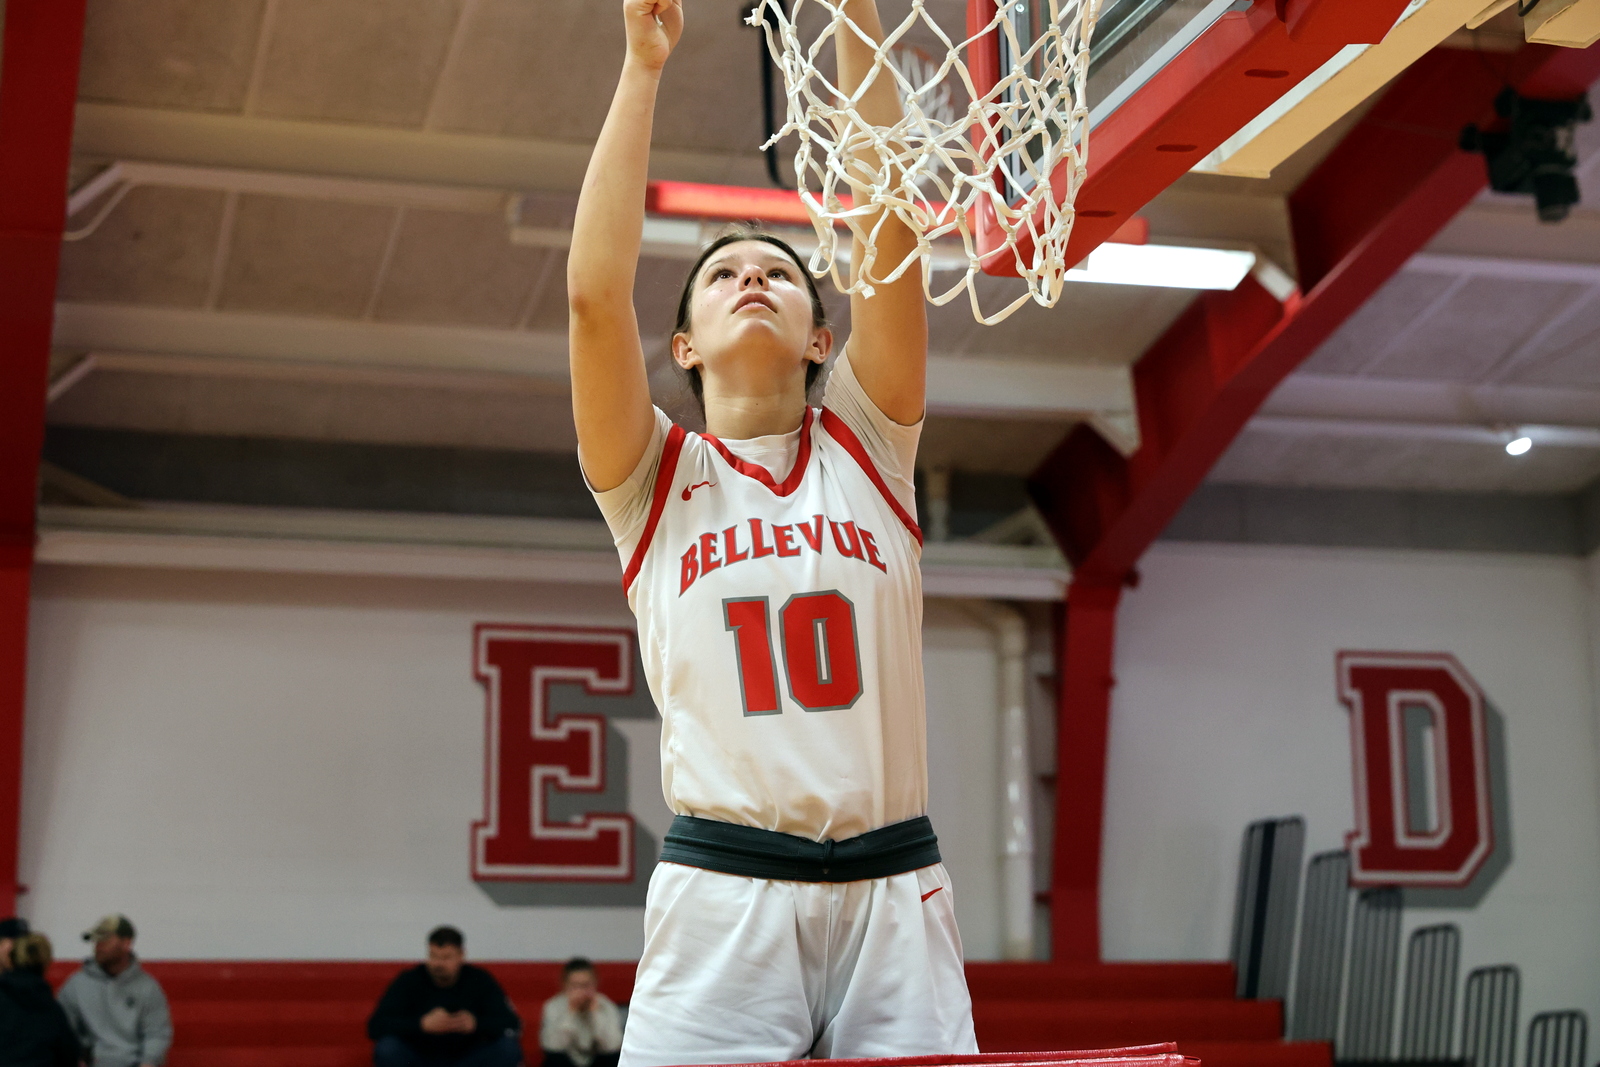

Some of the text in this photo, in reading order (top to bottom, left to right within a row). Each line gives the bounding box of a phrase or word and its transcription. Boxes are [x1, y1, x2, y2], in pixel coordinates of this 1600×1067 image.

[679, 514, 887, 598] BELLEVUE
[722, 589, 864, 717] 10
[471, 622, 635, 884] E
[1335, 649, 1495, 887] D
